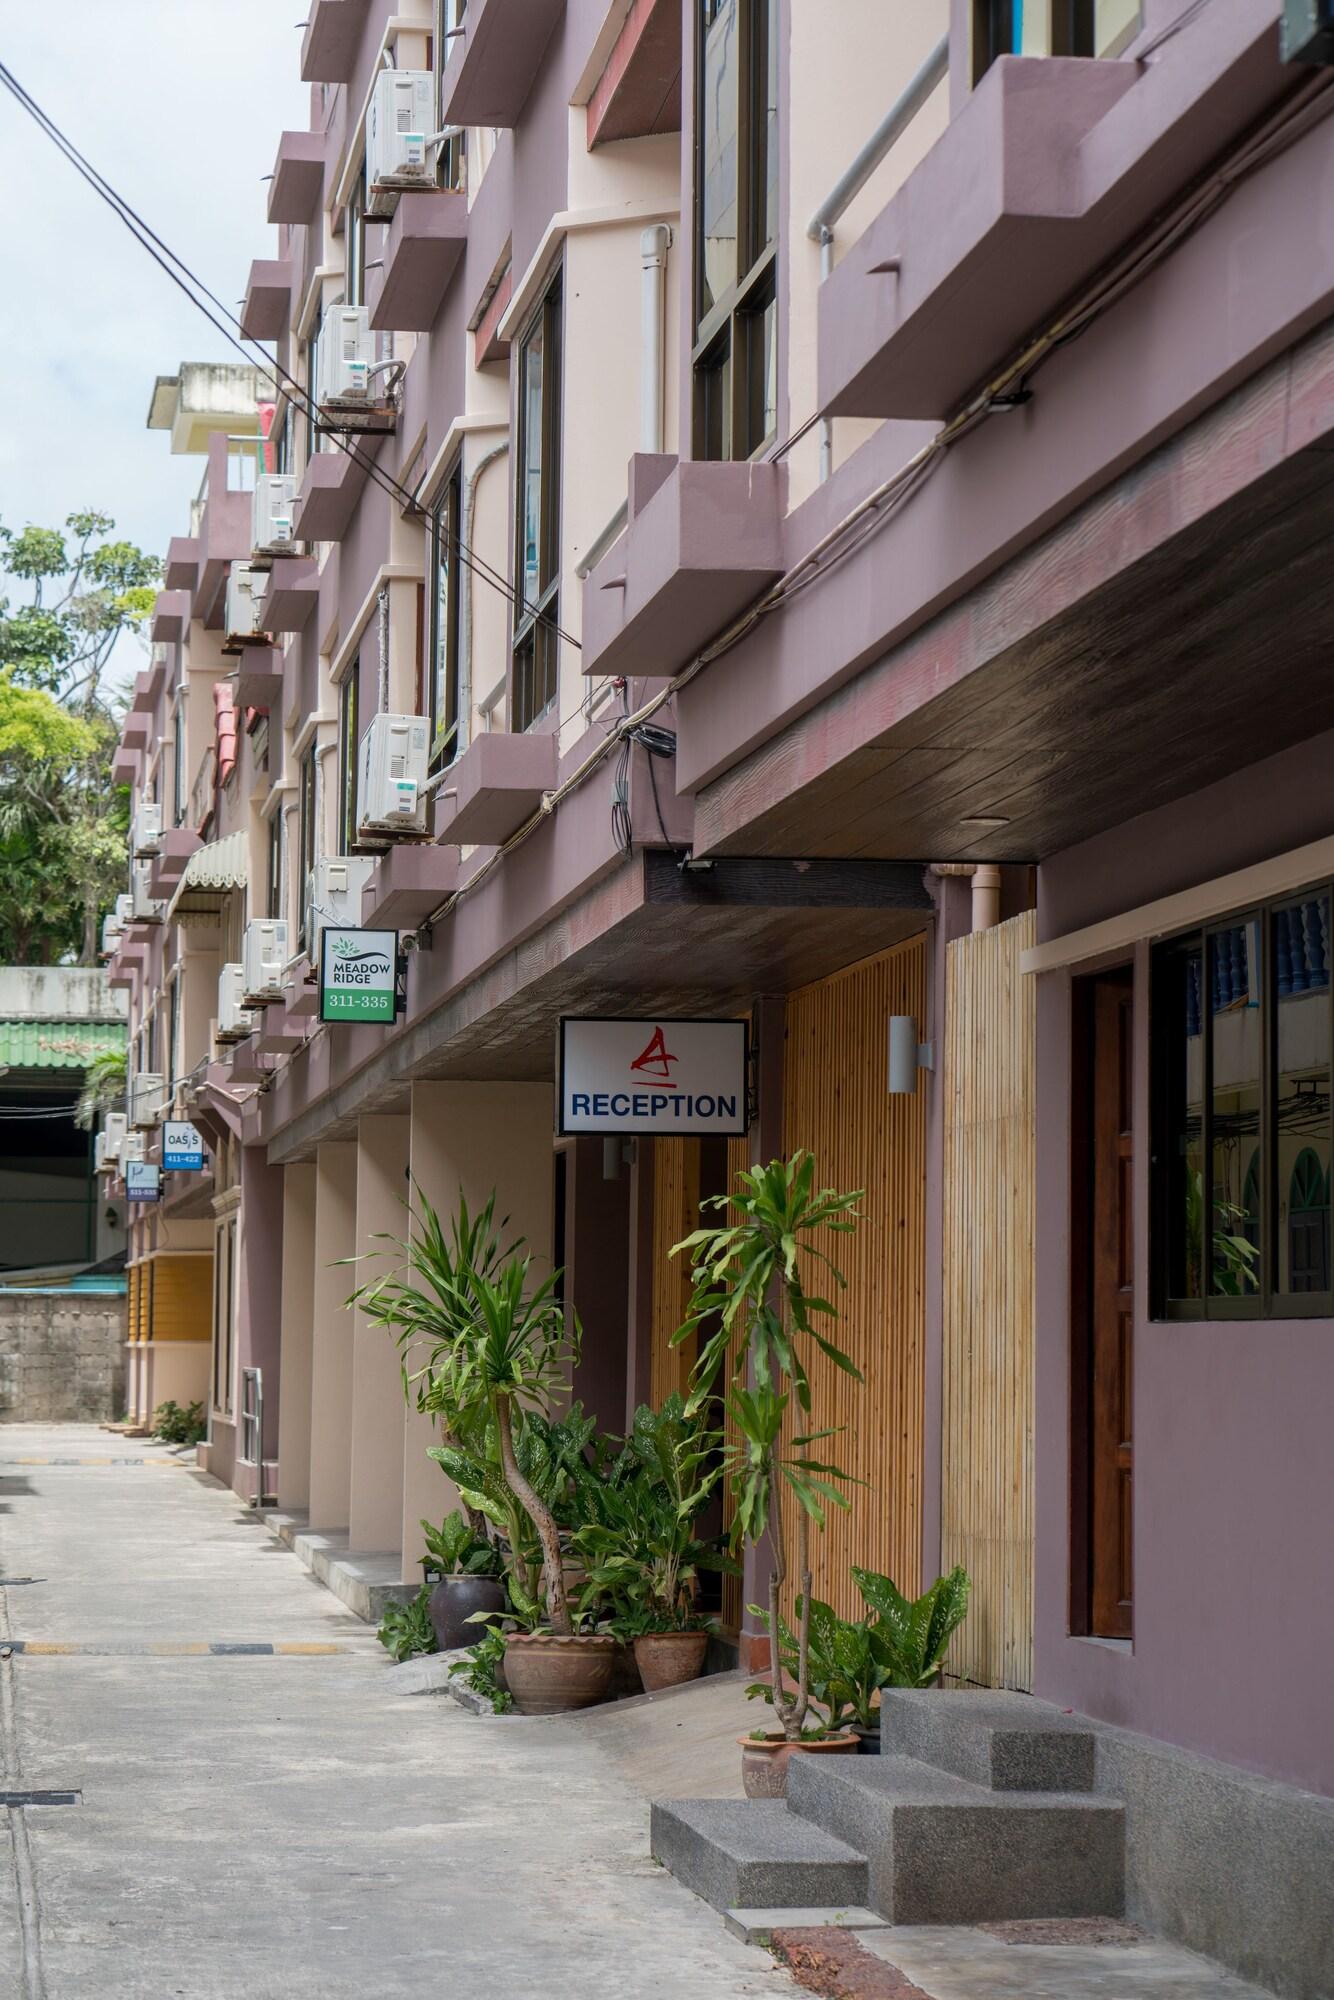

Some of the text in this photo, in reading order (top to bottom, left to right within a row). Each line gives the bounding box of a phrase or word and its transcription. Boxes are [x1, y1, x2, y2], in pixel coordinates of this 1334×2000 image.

[333, 963, 391, 974] MEADOW
[333, 973, 371, 984] RIDGE
[329, 994, 388, 1009] 311-335
[572, 1093, 736, 1118] RECEPTION
